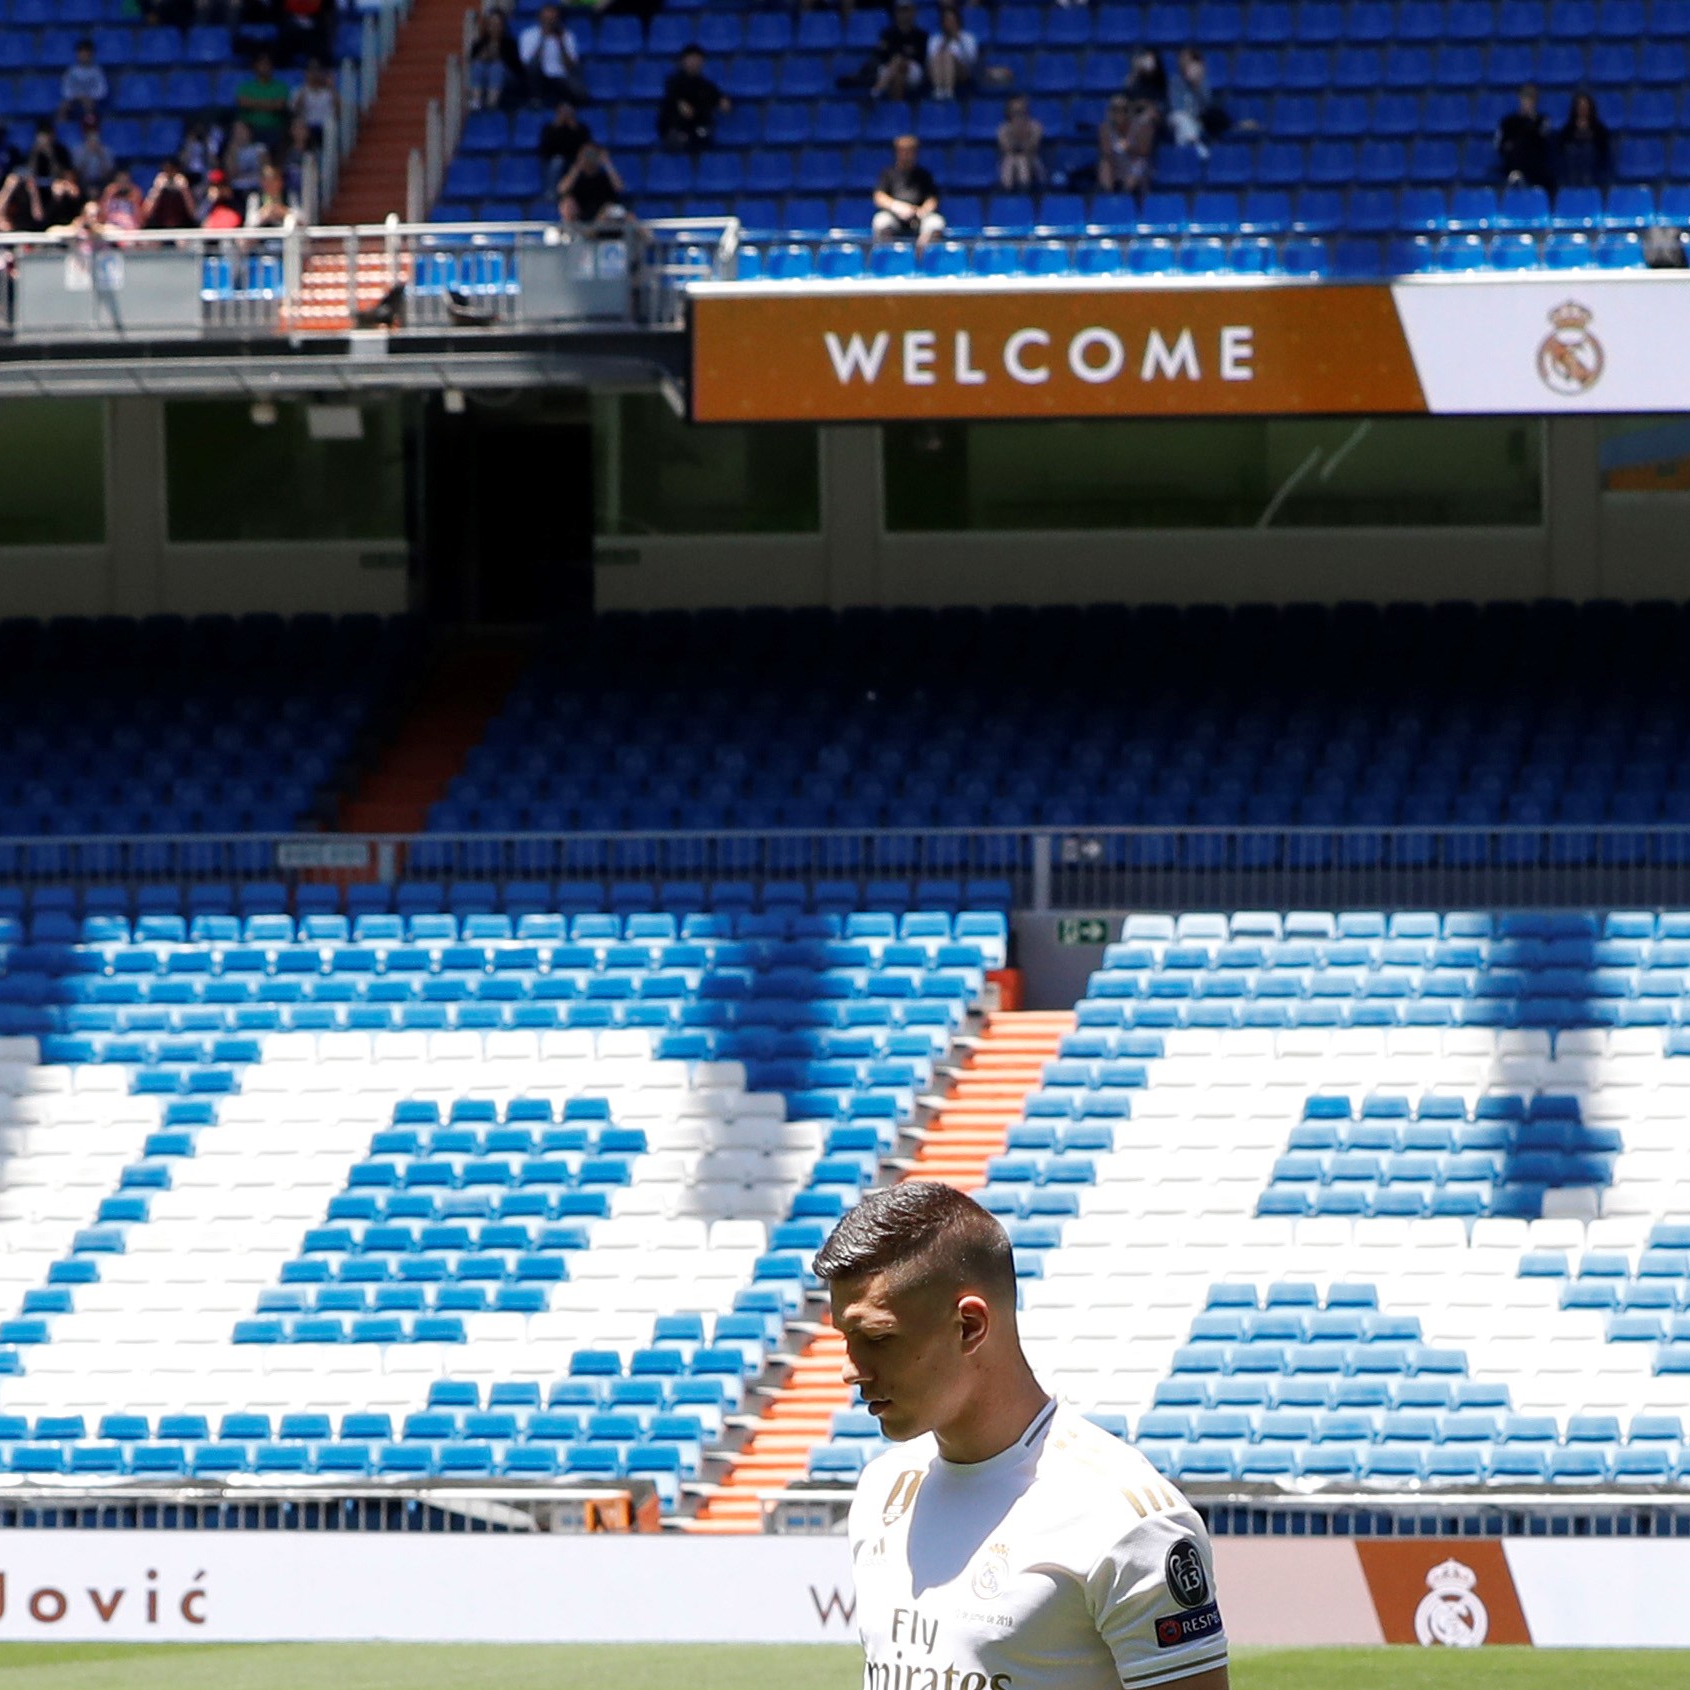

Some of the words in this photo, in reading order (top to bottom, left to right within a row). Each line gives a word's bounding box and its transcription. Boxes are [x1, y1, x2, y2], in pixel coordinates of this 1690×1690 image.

[824, 325, 1256, 386] WELCOME
[1182, 1570, 1200, 1591] 13
[891, 1608, 939, 1655] Fly
